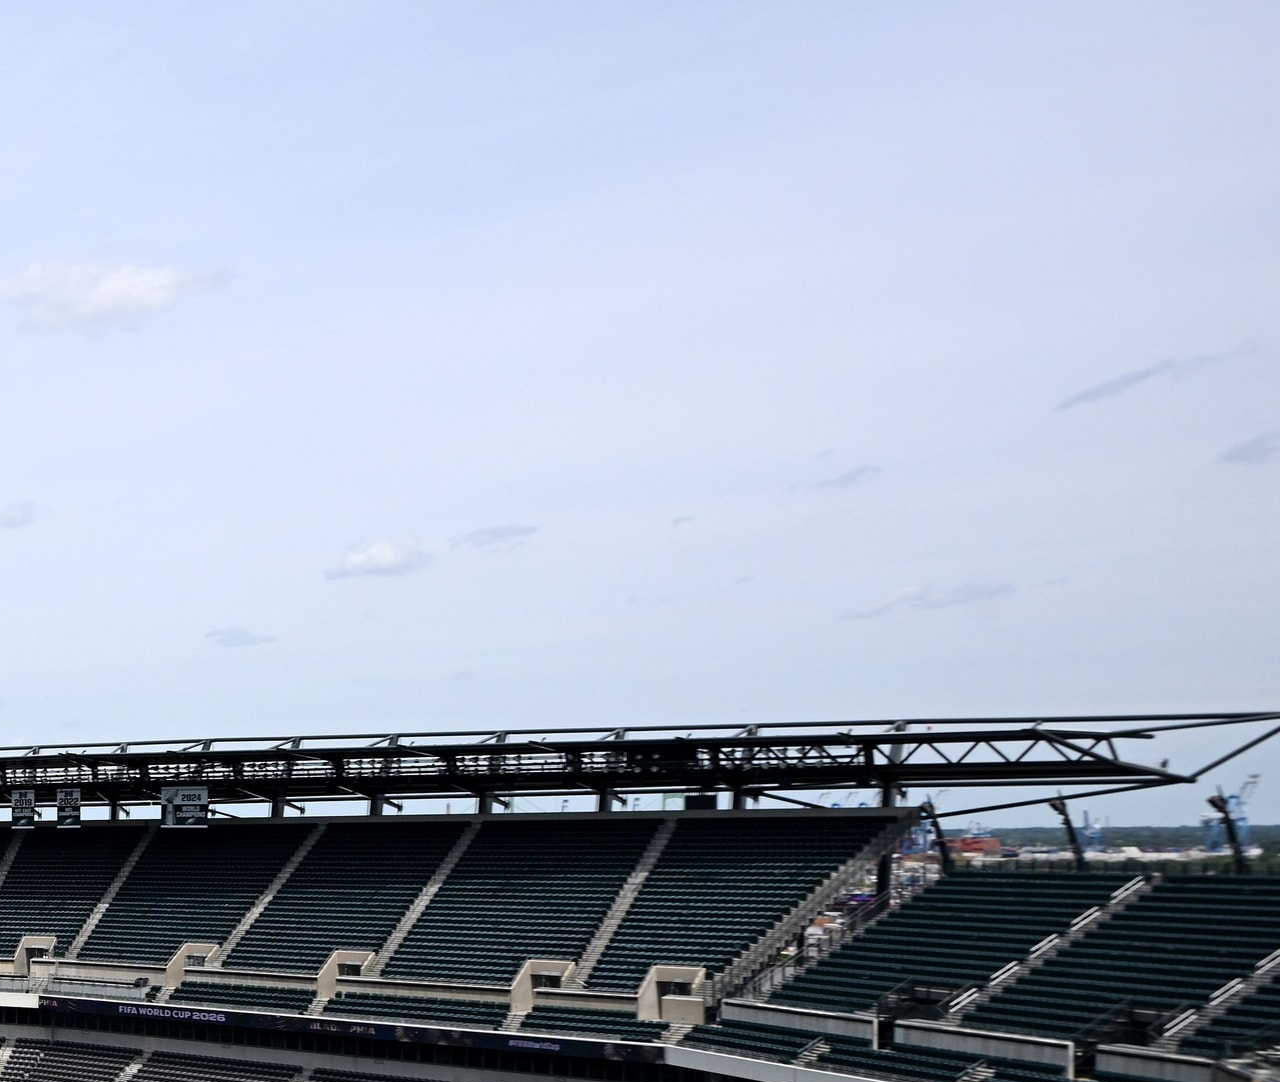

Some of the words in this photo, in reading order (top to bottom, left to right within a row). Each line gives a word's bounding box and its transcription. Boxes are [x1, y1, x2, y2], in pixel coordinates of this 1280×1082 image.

[14, 798, 32, 806] 2019
[59, 797, 79, 805] 2022
[181, 794, 201, 802] 2024
[119, 1006, 137, 1014] FIFA
[139, 1008, 171, 1017] WORLD
[192, 1012, 225, 1022] 2026
